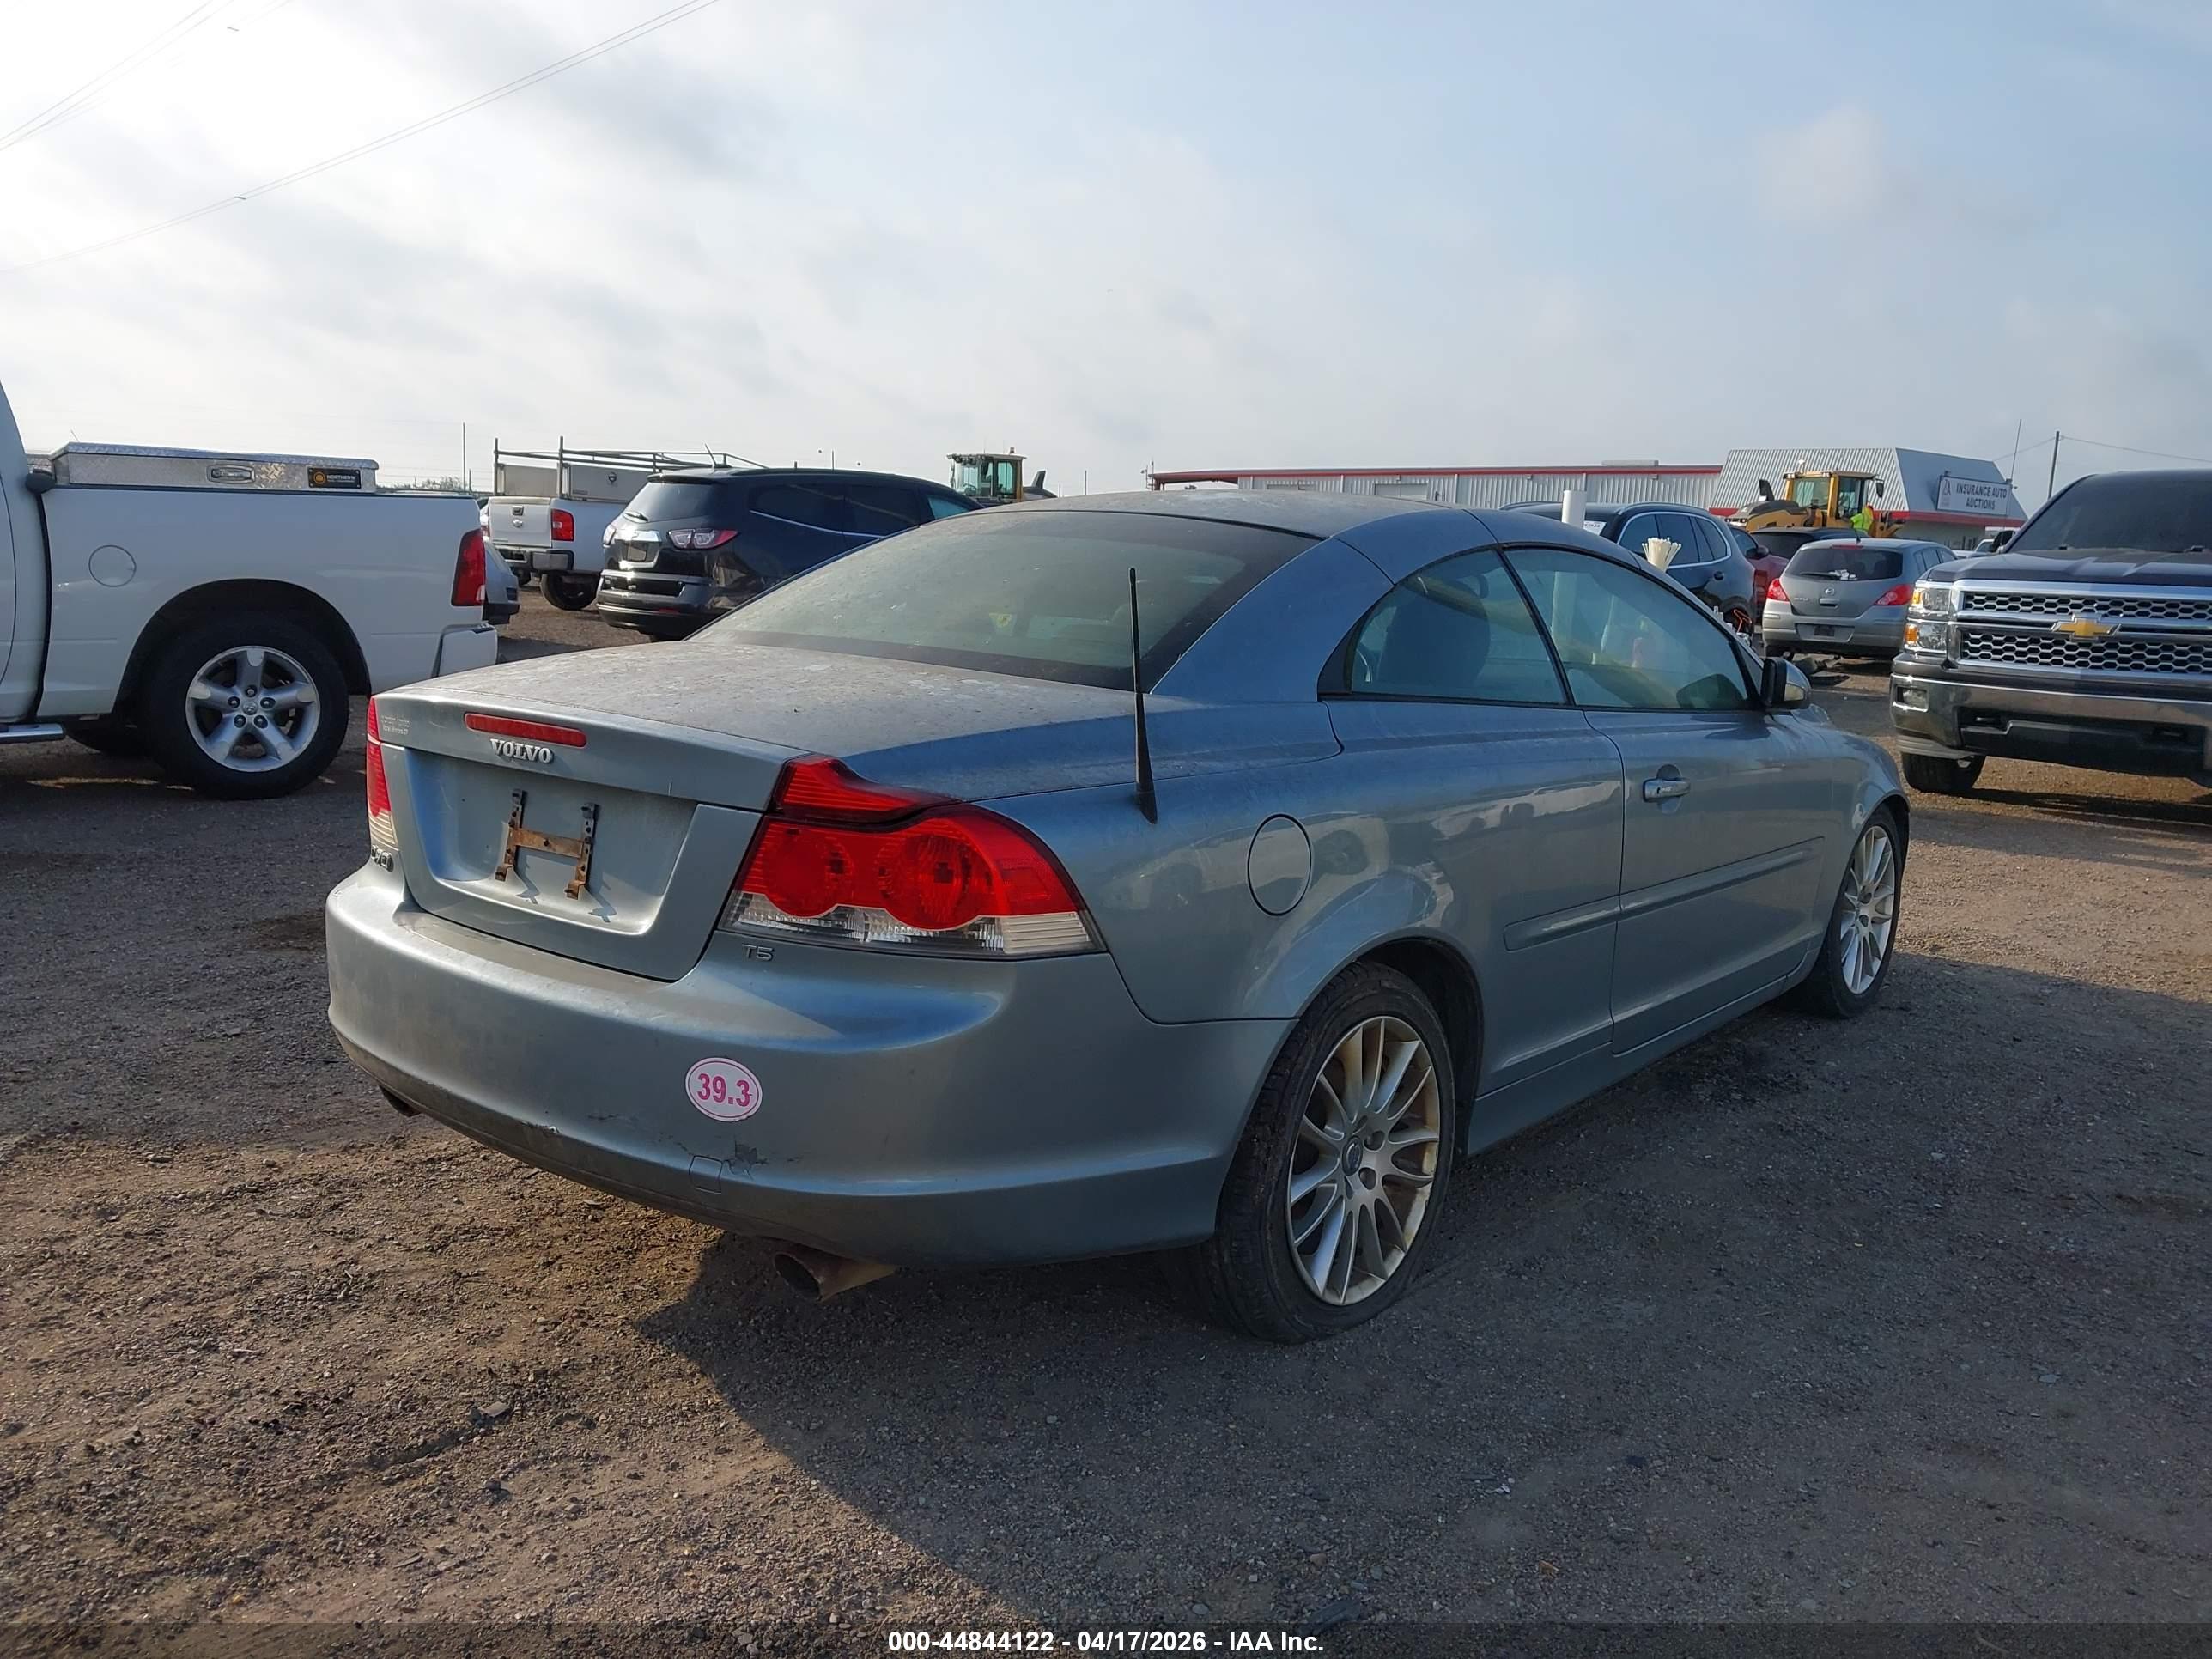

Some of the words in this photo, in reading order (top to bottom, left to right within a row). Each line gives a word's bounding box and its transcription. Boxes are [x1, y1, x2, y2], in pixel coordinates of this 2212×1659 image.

[1956, 483, 1991, 497] INSURANCE
[1991, 487, 2008, 499] AUTO
[1965, 497, 1996, 510] AUCTIONS
[489, 738, 552, 763] VOLVO
[742, 944, 774, 961] T5
[696, 1073, 751, 1107] 39.3
